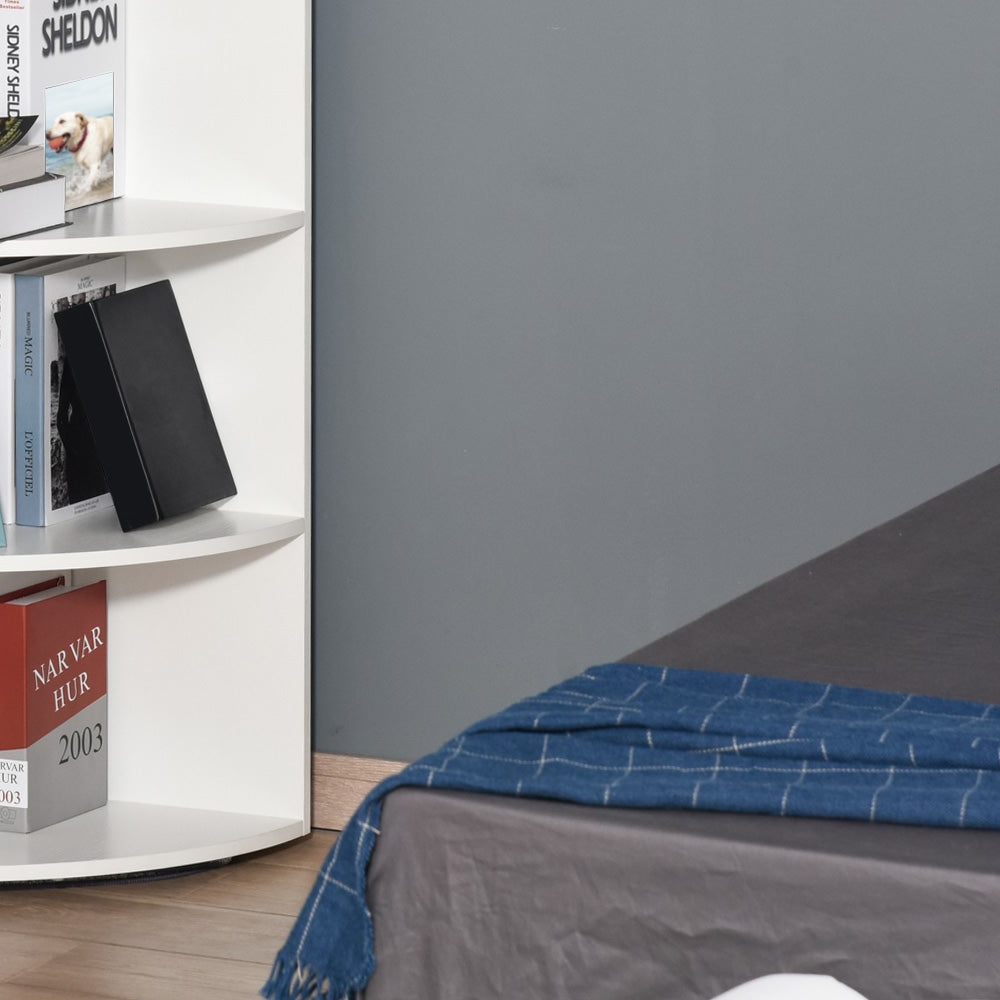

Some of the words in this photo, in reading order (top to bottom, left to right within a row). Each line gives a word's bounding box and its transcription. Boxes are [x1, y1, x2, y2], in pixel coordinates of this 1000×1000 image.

[7, 24, 20, 74] SIDNEY
[42, 3, 118, 58] SHELDON
[7, 76, 20, 118] SHELD
[24, 337, 33, 376] MAGIC
[32, 650, 70, 691] NAR
[68, 625, 104, 664] VAR
[53, 671, 91, 713] HUR
[58, 722, 103, 765] 2003
